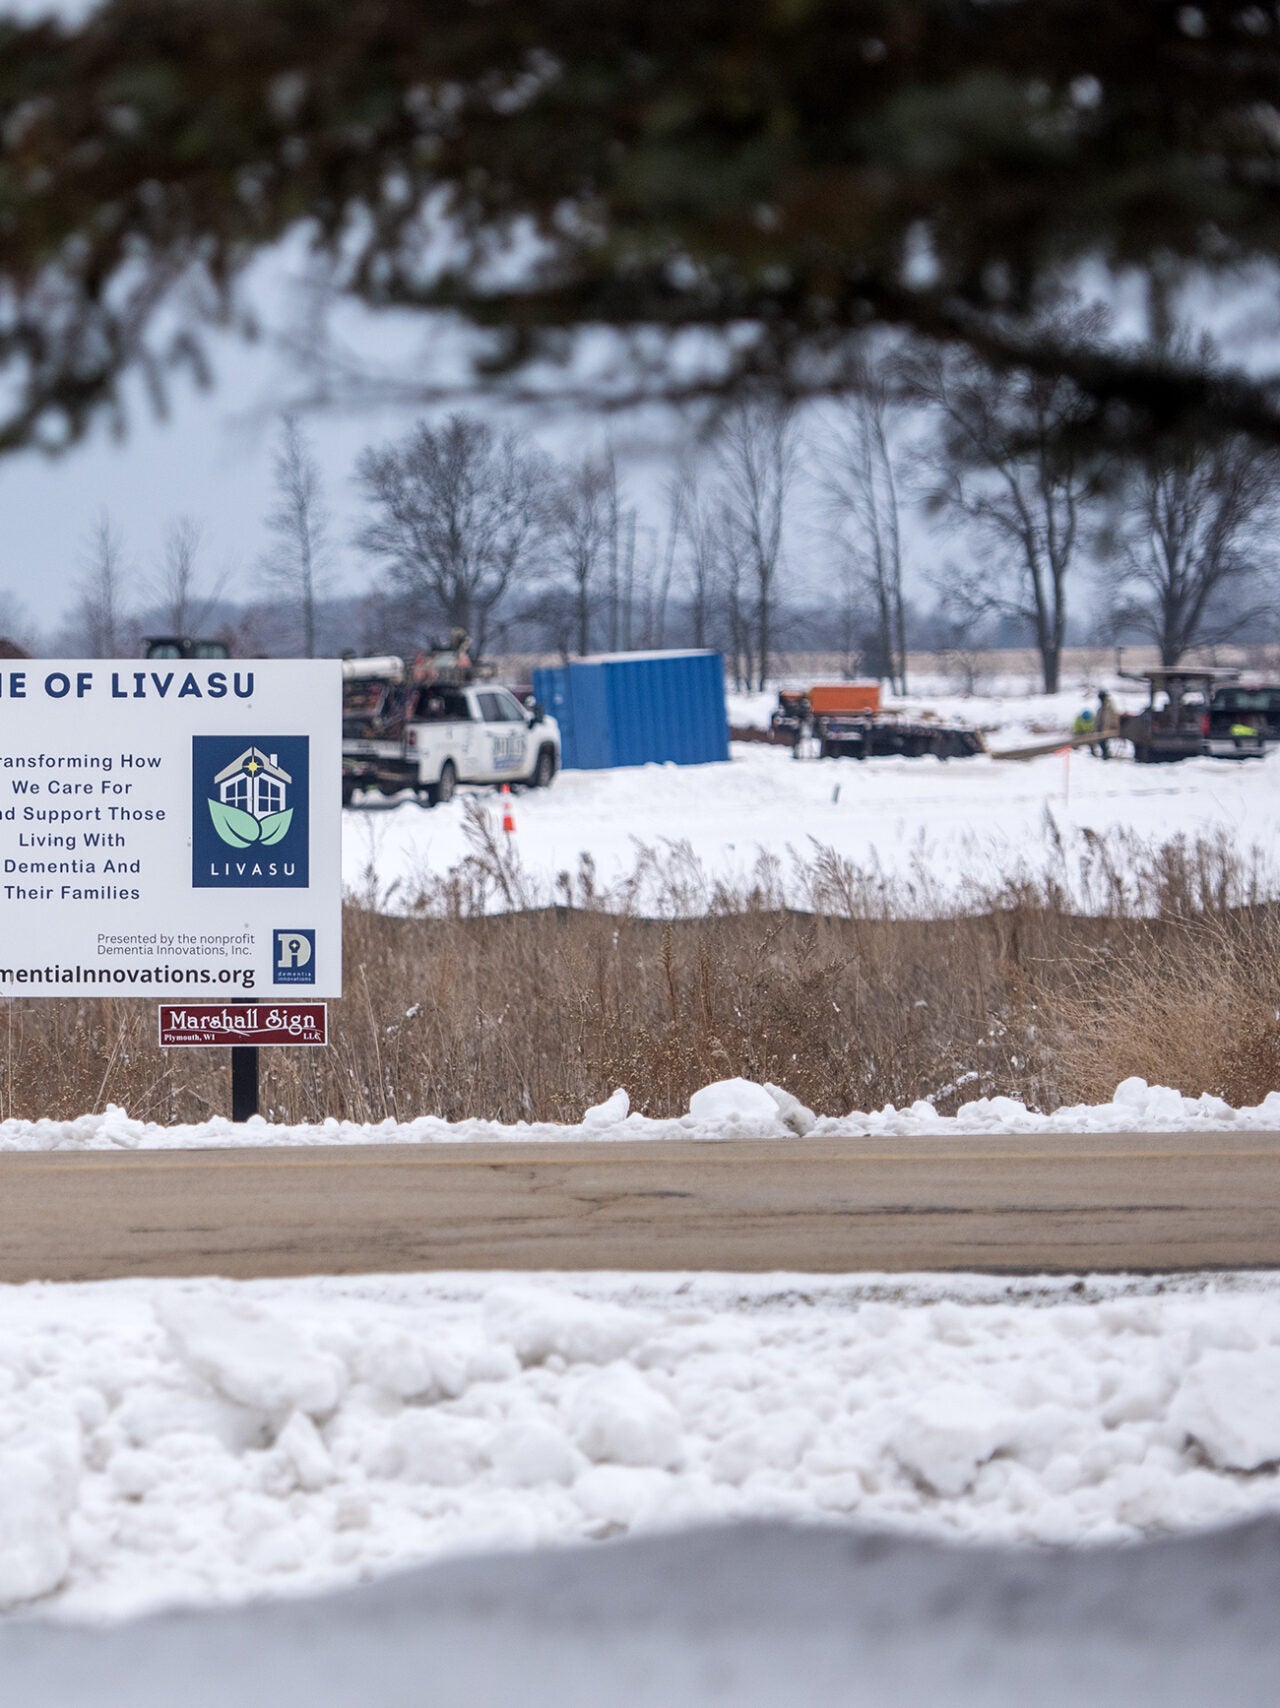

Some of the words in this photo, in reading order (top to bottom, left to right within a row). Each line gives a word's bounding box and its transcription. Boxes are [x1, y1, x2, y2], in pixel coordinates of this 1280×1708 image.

[44, 672, 93, 699] OF
[111, 671, 254, 699] LIVASU
[121, 753, 162, 768] How
[11, 780, 40, 795] We
[47, 780, 94, 795] Care
[101, 780, 133, 795] For
[23, 806, 102, 824] Support
[108, 806, 166, 821] Those
[19, 832, 76, 851] Living
[83, 832, 125, 847] With
[4, 859, 96, 874] Dementia
[103, 859, 140, 874] And
[211, 863, 295, 876] LIVASU
[3, 885, 54, 900] Their
[61, 885, 140, 900] Families
[97, 933, 157, 945] Presented
[160, 933, 175, 947] by
[177, 933, 197, 945] the
[200, 933, 255, 947] nonprofit
[97, 944, 154, 956] Dementia
[156, 944, 229, 958] Innovations,
[231, 944, 252, 956] Inc.
[169, 1008, 259, 1030] Marshall
[265, 1009, 316, 1036] Sign
[163, 1033, 202, 1042] Plymouth,
[203, 1033, 216, 1041] WI
